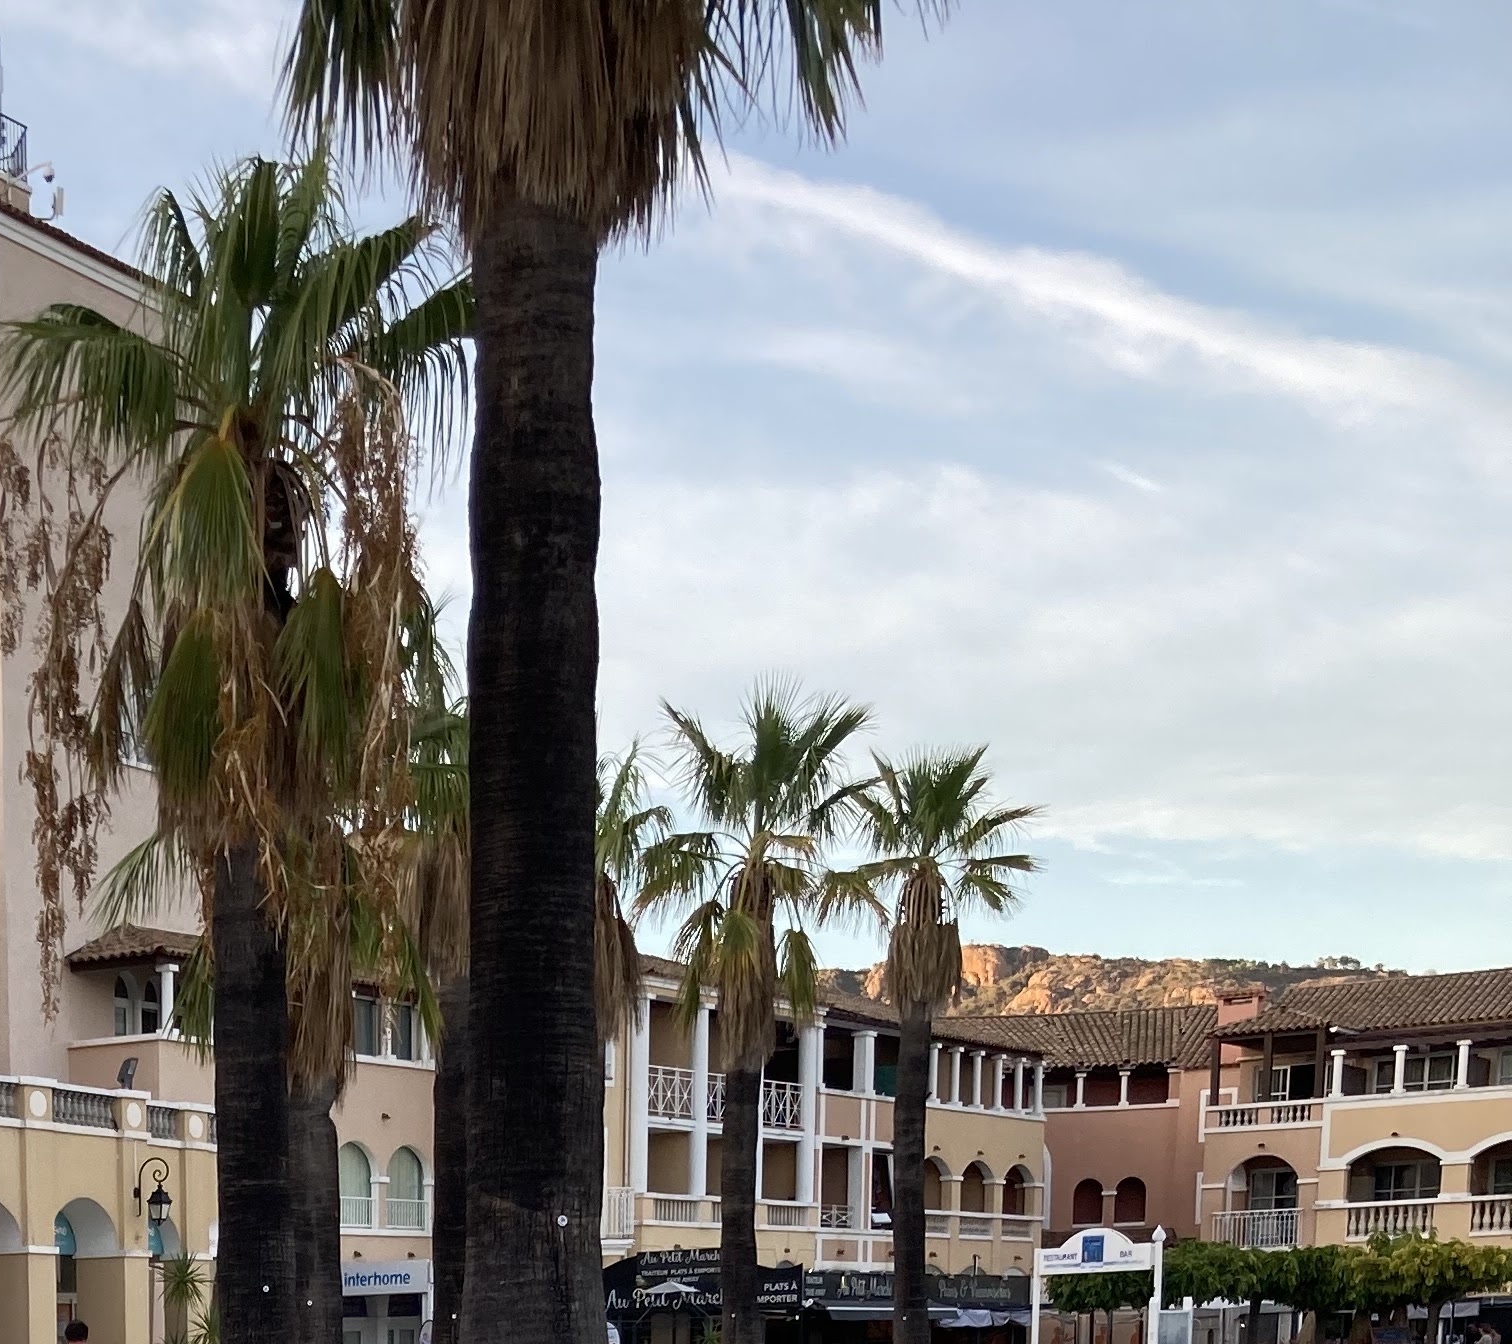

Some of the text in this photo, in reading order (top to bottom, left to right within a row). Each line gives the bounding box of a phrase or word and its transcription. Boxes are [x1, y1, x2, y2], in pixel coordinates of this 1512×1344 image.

[640, 1249, 721, 1265] Au Petit March
[1119, 1250, 1133, 1258] BAR
[344, 1271, 411, 1287] interhome
[764, 1283, 789, 1292] PLATS
[605, 1289, 630, 1312] Au
[756, 1295, 798, 1304] MPORTER
